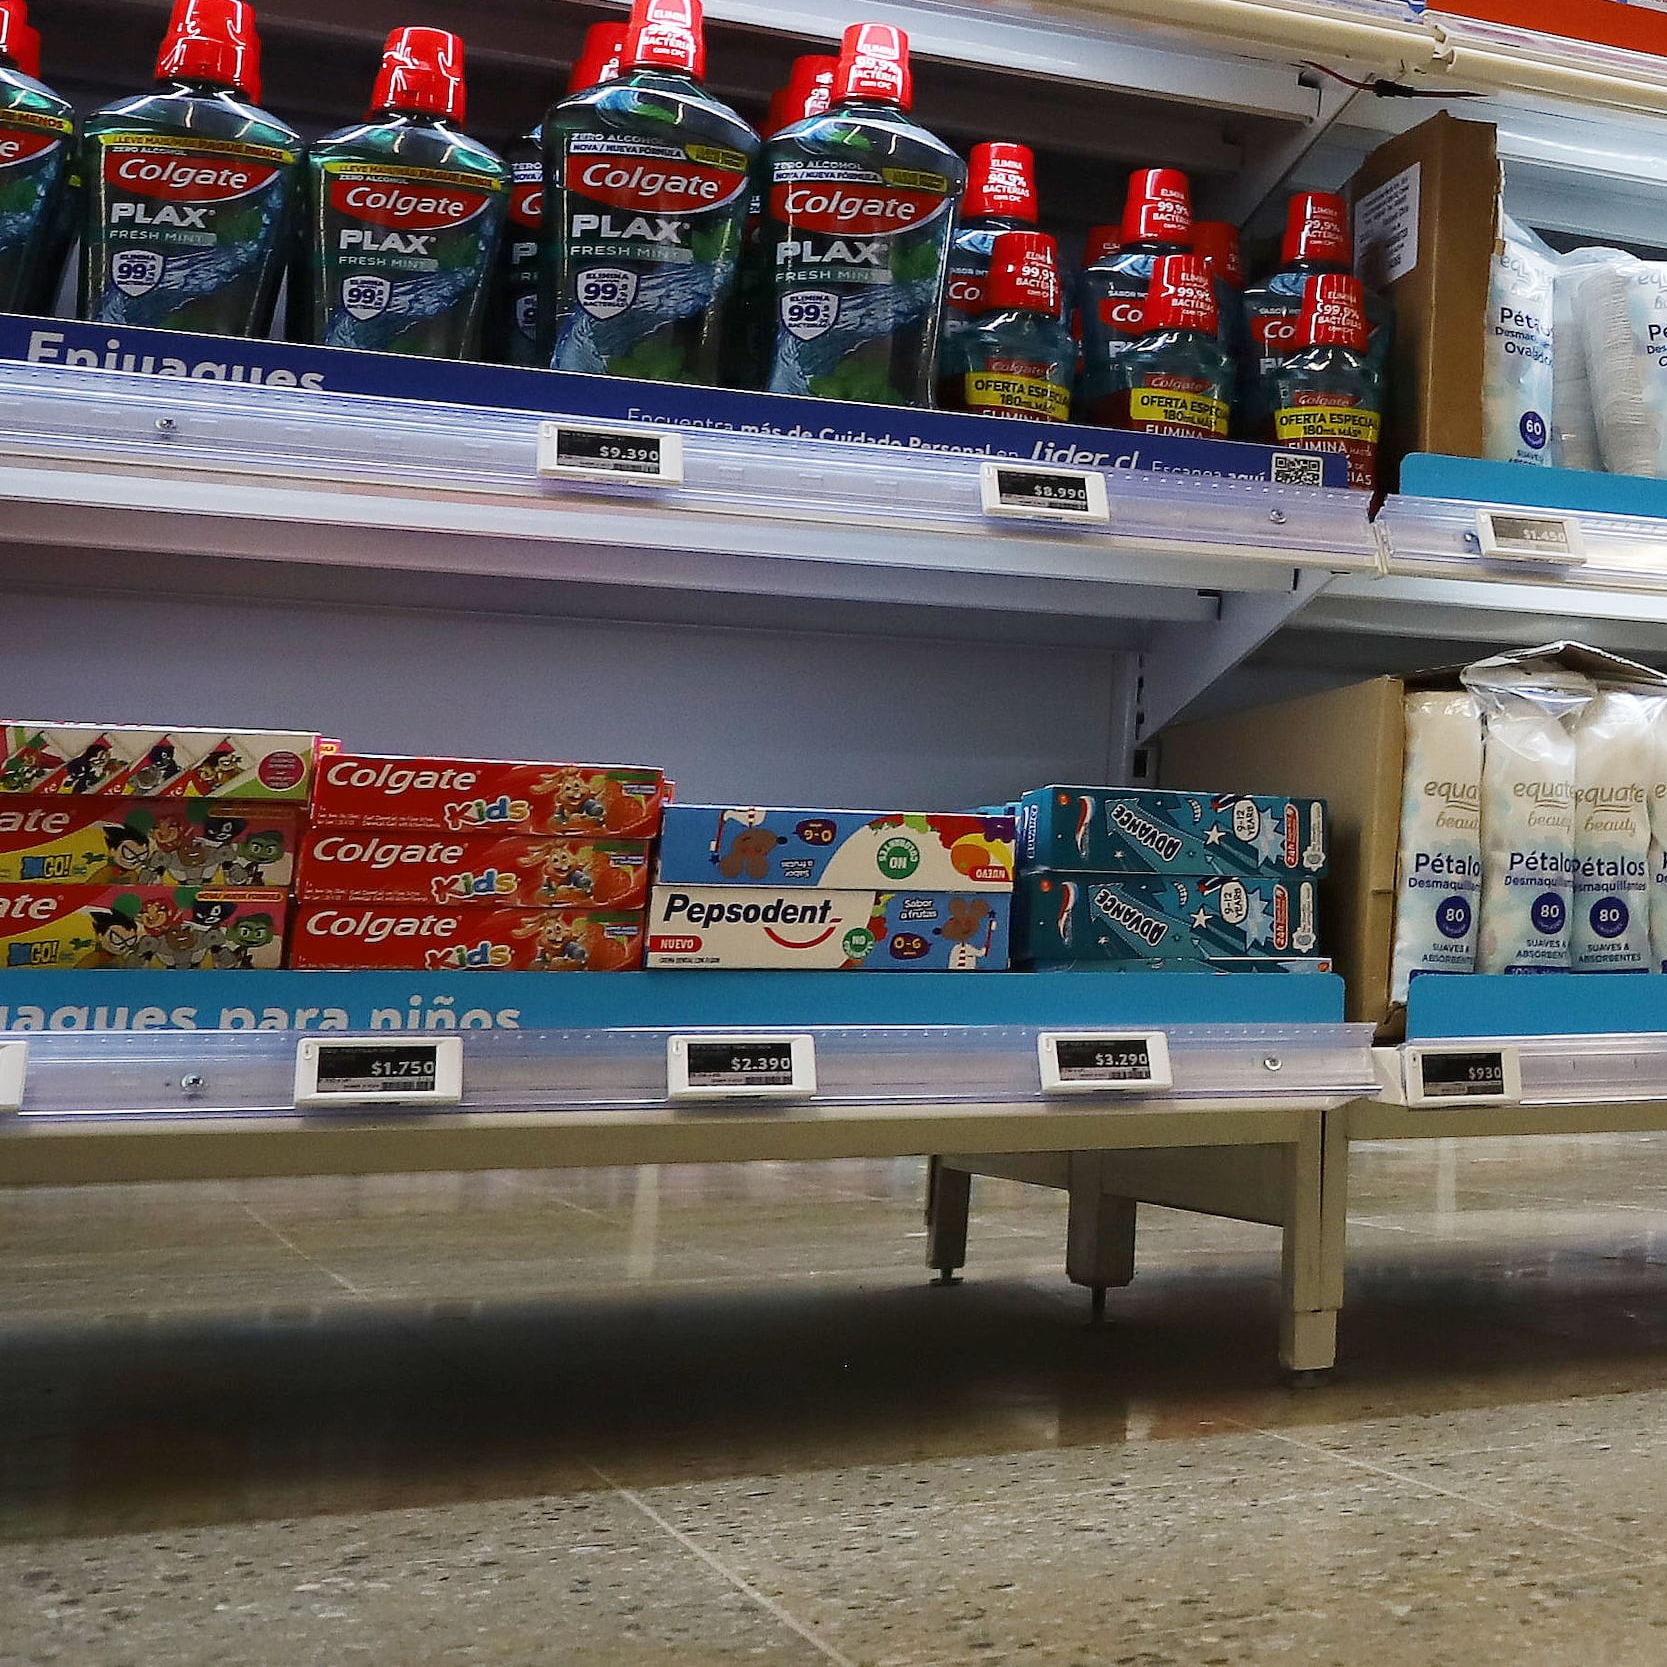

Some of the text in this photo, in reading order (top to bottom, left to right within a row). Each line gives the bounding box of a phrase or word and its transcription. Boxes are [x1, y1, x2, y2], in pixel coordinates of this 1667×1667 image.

[119, 157, 248, 189] Colgate
[581, 163, 719, 199] Colgate
[346, 188, 465, 217] Colgate
[784, 190, 915, 219] Colgate
[111, 203, 206, 228] PLAX
[571, 214, 681, 243] PLAX
[340, 230, 428, 254] PLAX
[776, 241, 885, 265] PLAX
[776, 271, 834, 283] FRESH
[1140, 396, 1190, 412] OFERTA
[1525, 420, 1542, 434] 60
[600, 445, 659, 461] $9.390
[1033, 484, 1086, 500] $8.990
[326, 762, 477, 793] Colgate
[445, 797, 530, 832] Kids
[1237, 810, 1245, 832] 9-12
[1584, 819, 1635, 834] beauty
[1112, 803, 1183, 862] ADVANCE
[313, 836, 464, 867] Colgate
[431, 869, 516, 904] Kids
[663, 893, 832, 927] Pepsodent
[1095, 889, 1169, 947] ADVANCE
[1446, 909, 1464, 922] 80
[1540, 905, 1559, 918] 80
[1599, 909, 1619, 922] 80
[306, 909, 457, 942] Colgate
[425, 941, 514, 970] Kids
[660, 938, 695, 950] NUEVO
[892, 937, 926, 954] 0-6
[371, 1060, 435, 1076] $1.750
[731, 1056, 791, 1072] $2.390
[1096, 1051, 1148, 1066] $3.290
[1468, 1067, 1501, 1080] $930
